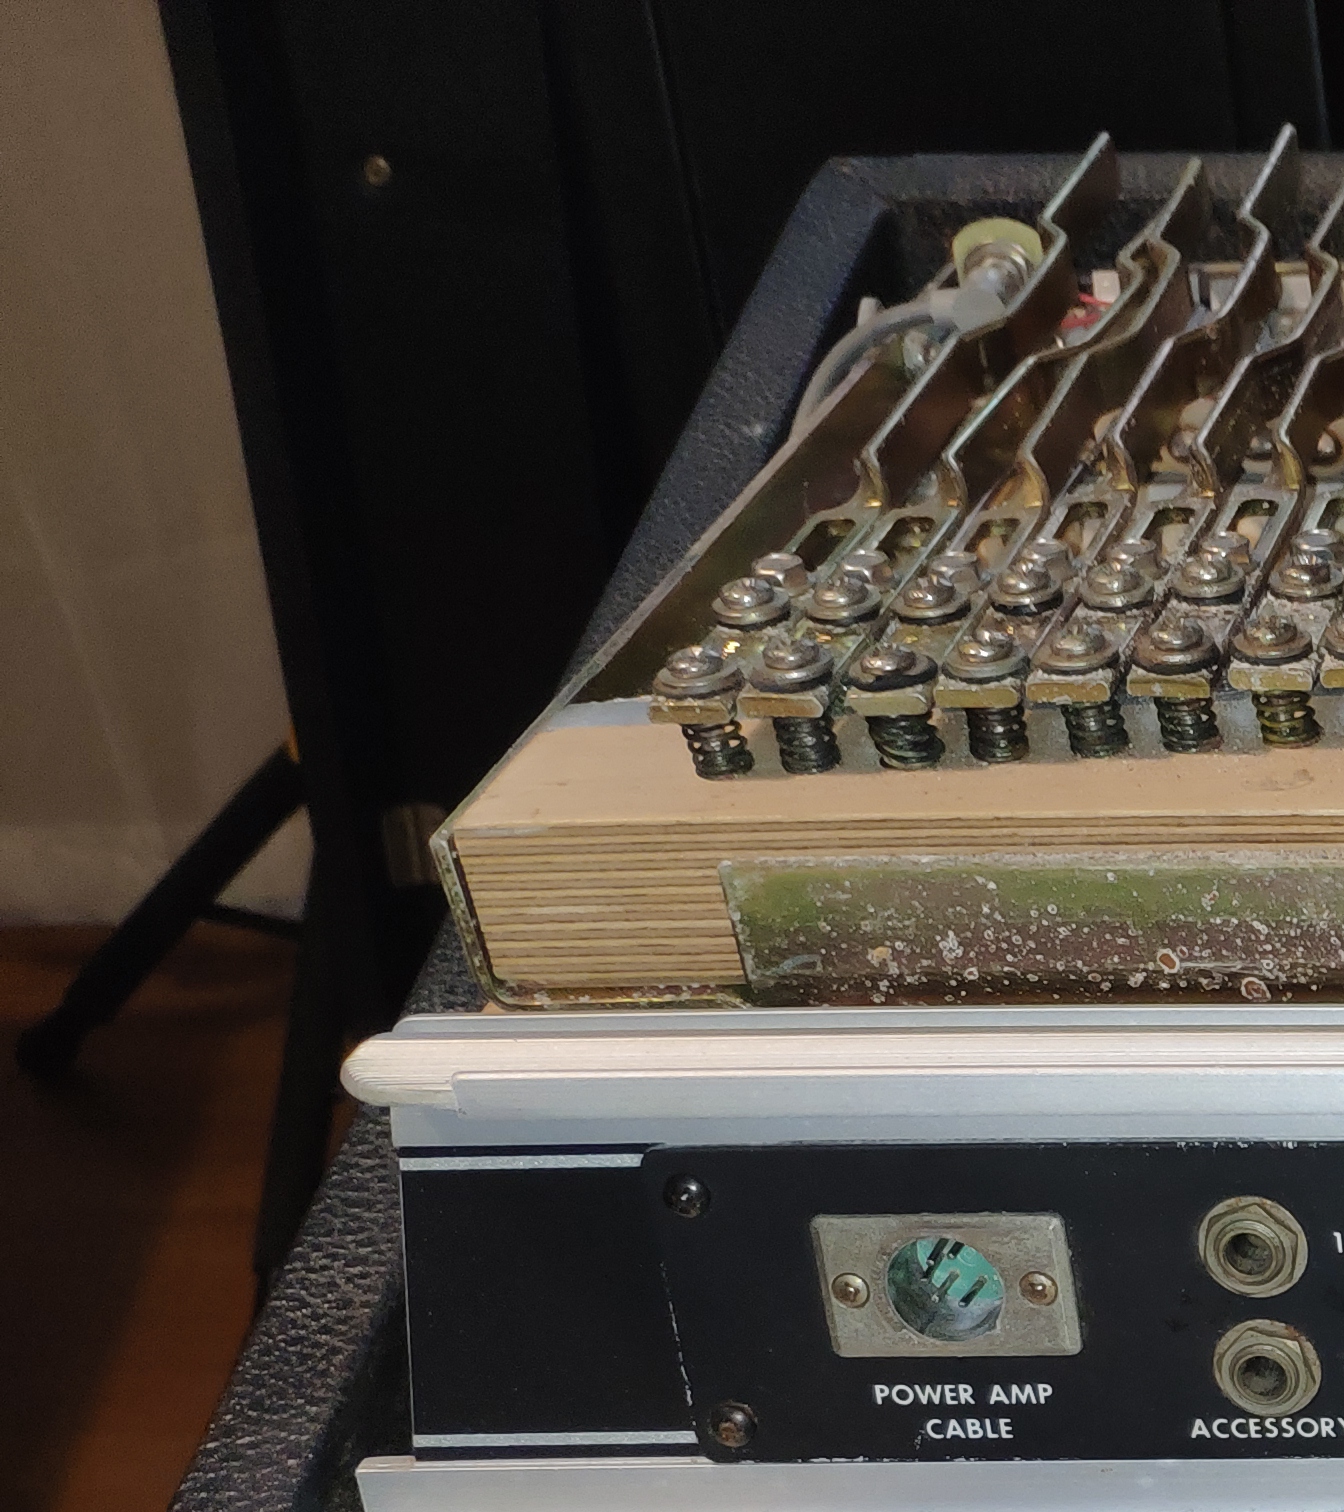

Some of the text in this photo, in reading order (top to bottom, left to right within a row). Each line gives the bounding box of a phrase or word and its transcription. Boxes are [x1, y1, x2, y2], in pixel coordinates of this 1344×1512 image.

[1332, 1231, 1344, 1254] 1
[873, 1383, 1053, 1406] POWER AMP
[925, 1418, 1014, 1440] CABLE
